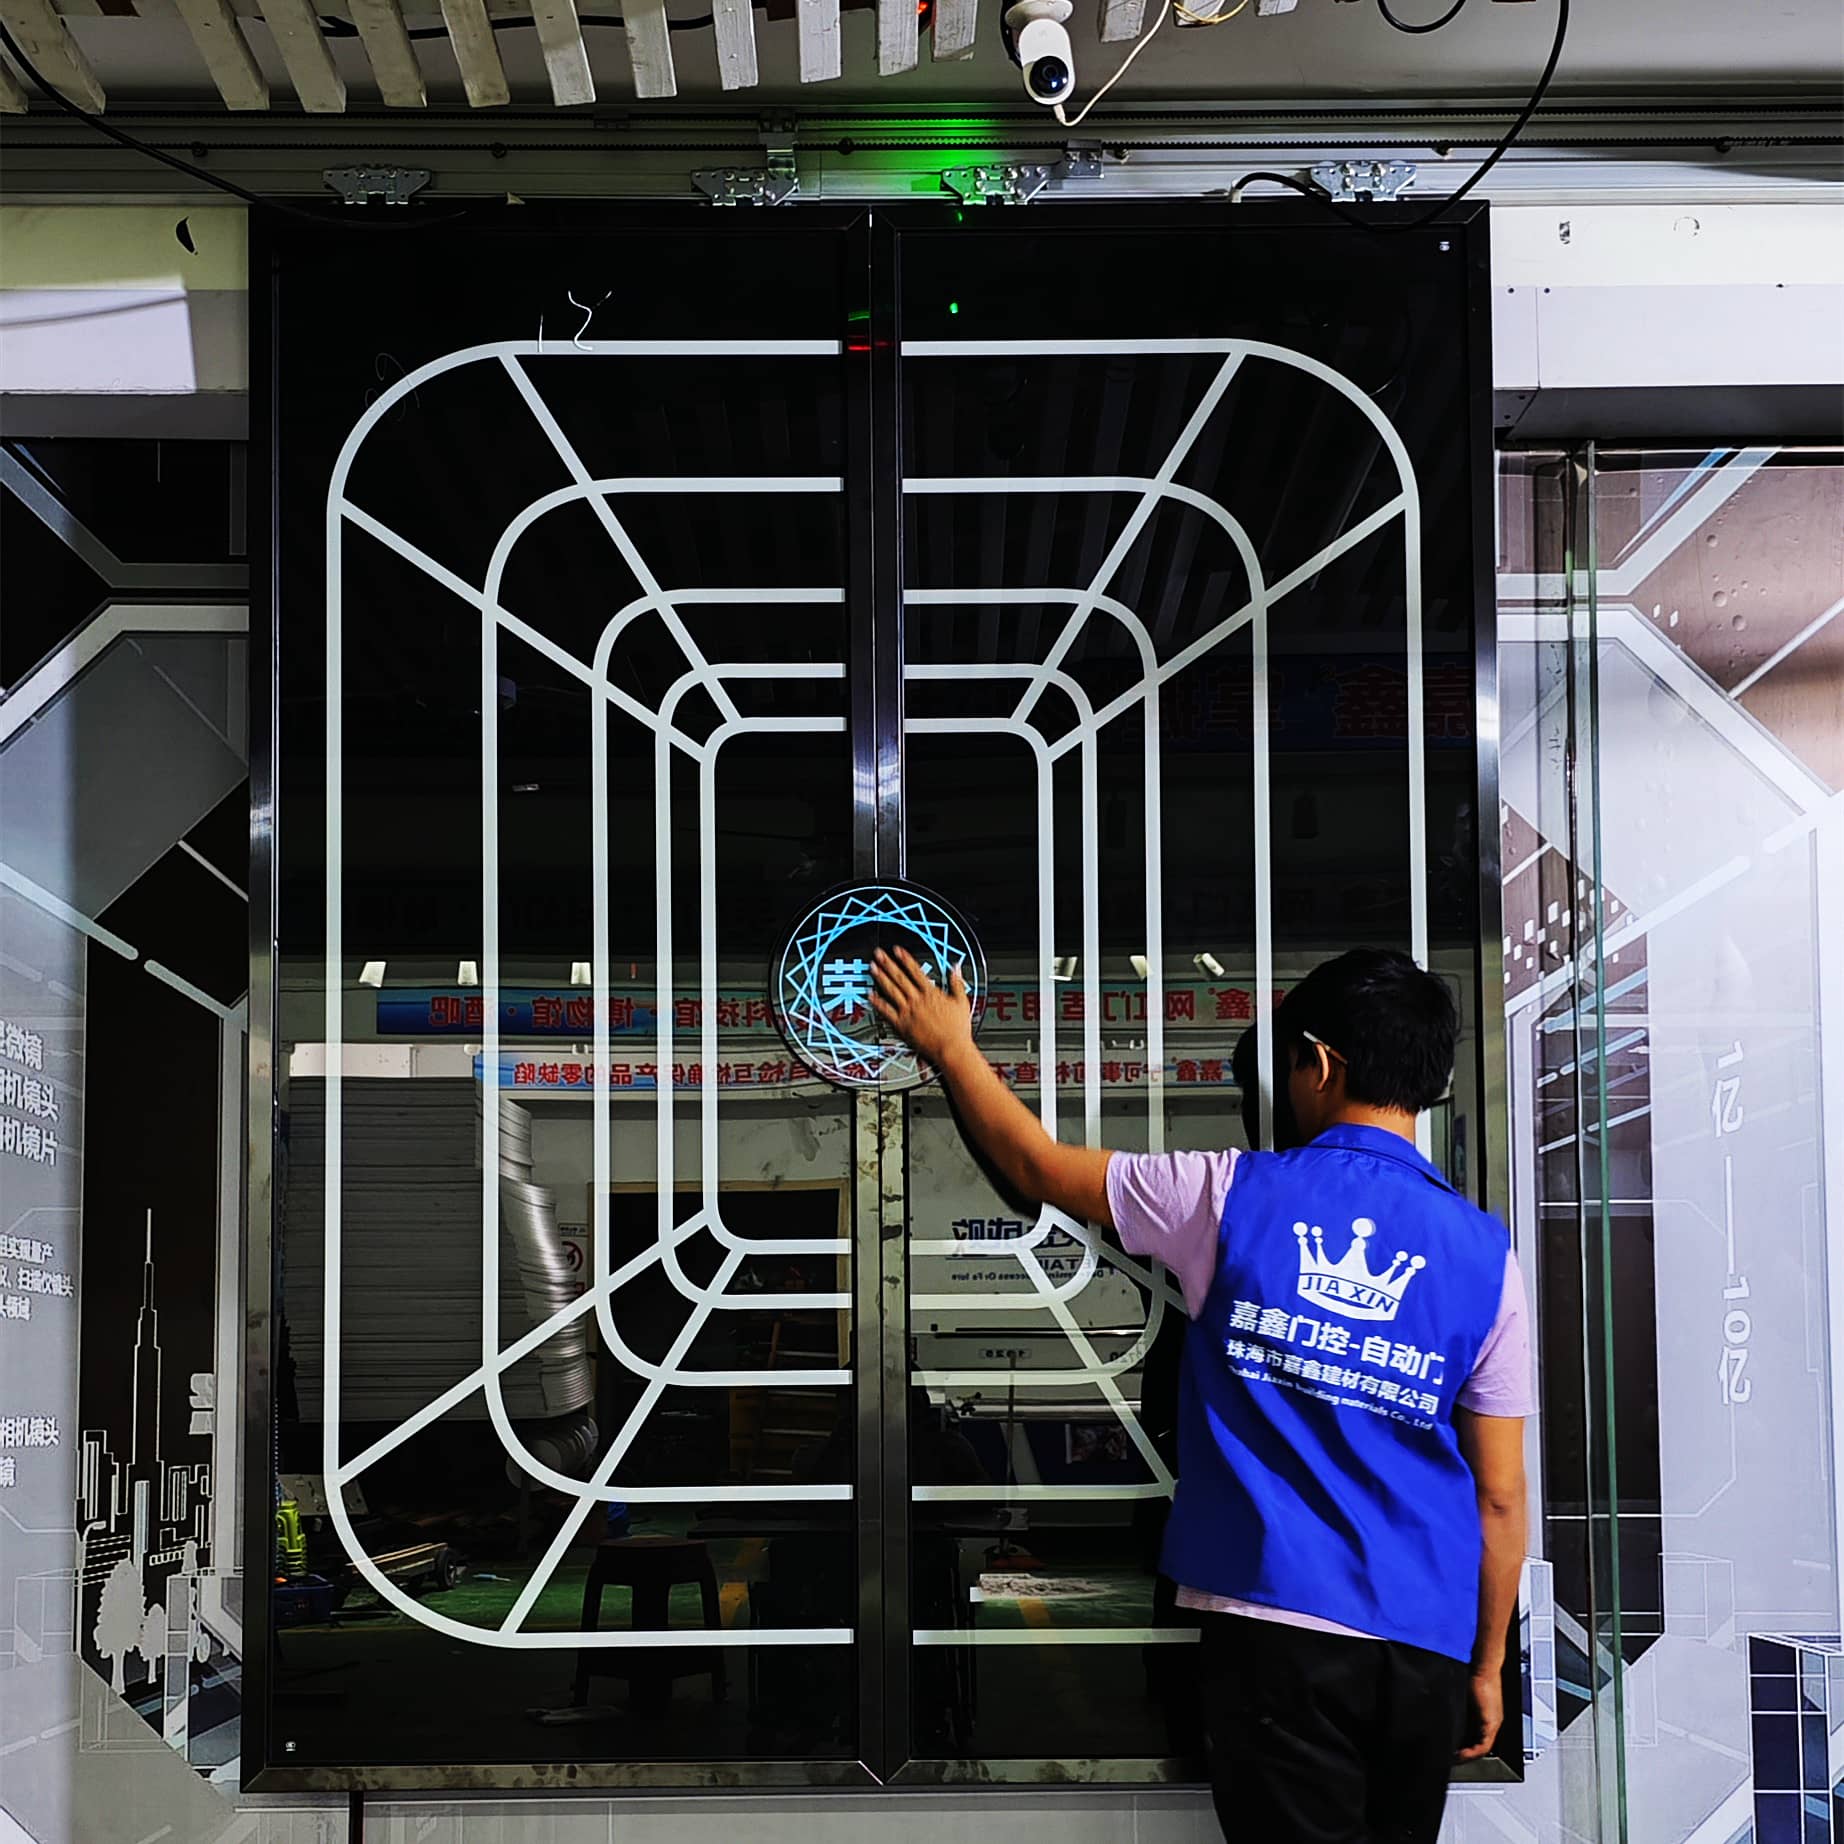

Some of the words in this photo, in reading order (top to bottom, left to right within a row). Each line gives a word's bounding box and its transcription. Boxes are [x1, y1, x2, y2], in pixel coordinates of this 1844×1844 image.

[0, 1019, 43, 1070] 微镜
[0, 1068, 59, 1122] 机镜头
[0, 1116, 58, 1166] 机镜片
[1302, 1275, 1339, 1295] JIA
[1350, 1283, 1395, 1314] XIN
